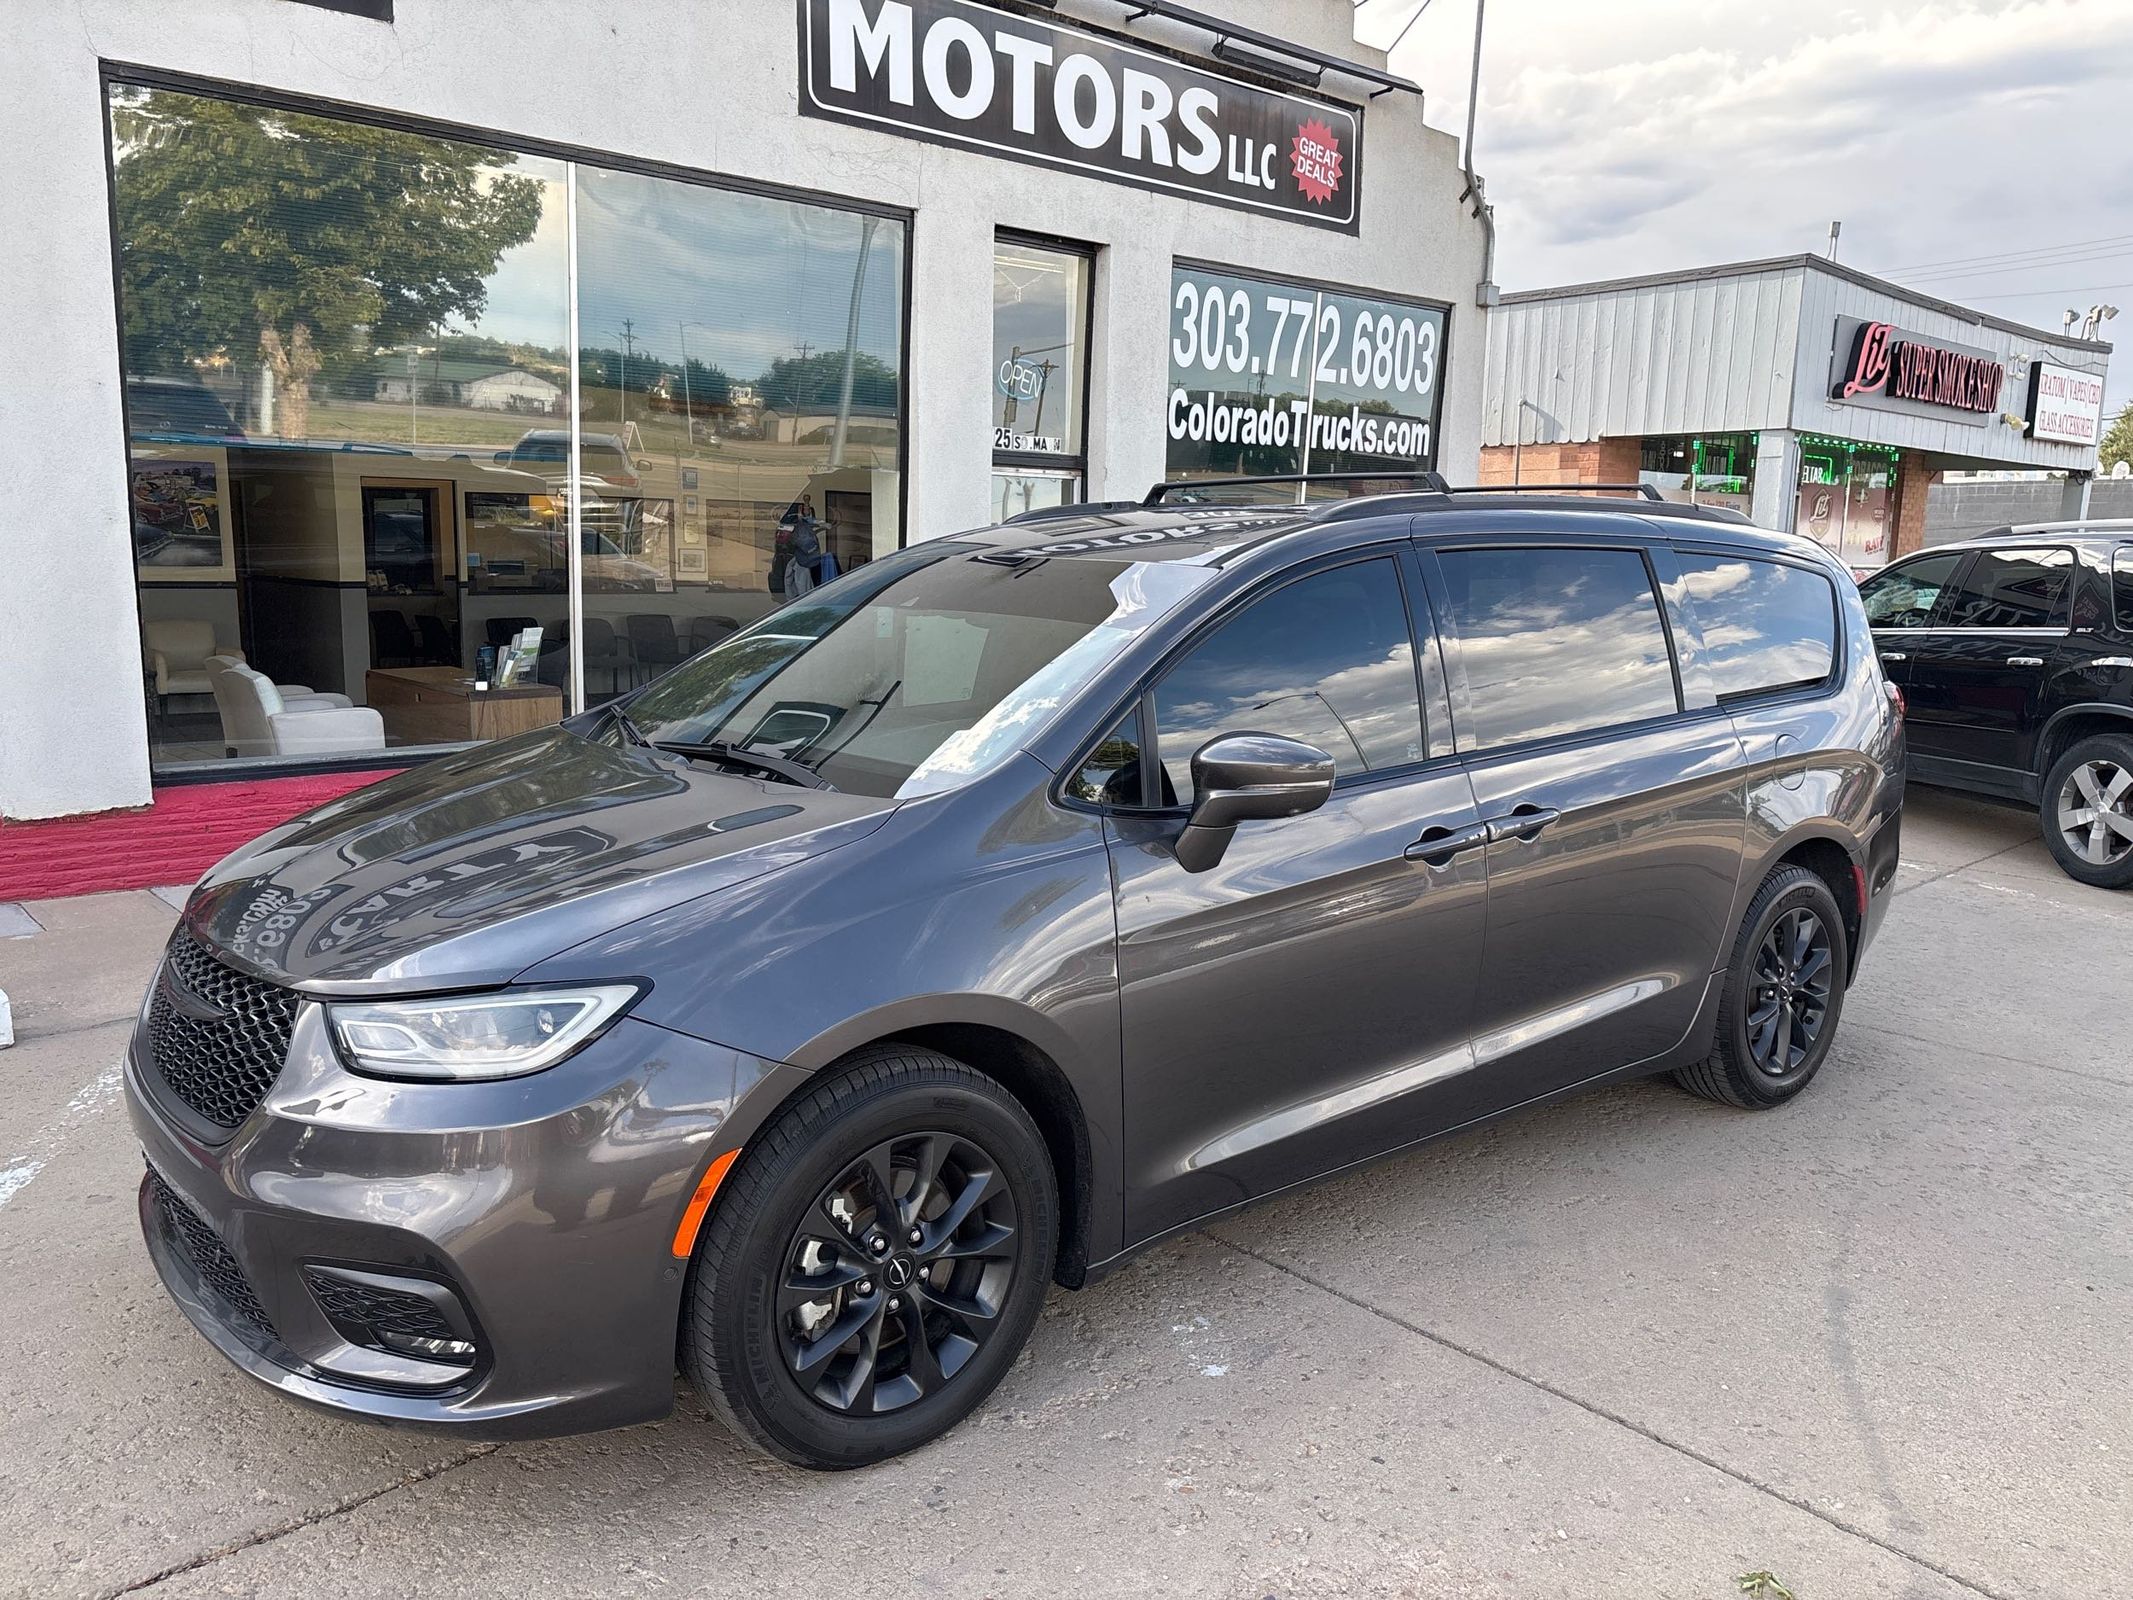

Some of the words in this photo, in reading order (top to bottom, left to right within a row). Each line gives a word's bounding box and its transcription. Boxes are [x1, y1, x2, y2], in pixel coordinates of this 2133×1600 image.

[829, 0, 1221, 175] MOTORS
[1227, 134, 1277, 190] LLC
[1296, 155, 1335, 188] DEALS
[1299, 136, 1338, 169] GREAT
[1172, 281, 1436, 395] 303.772.6803
[1000, 360, 1042, 398] OPEN
[1895, 341, 1937, 400] SUPER
[1935, 350, 1977, 409] SMOKE
[1973, 359, 2005, 413] SHOP
[1167, 387, 1430, 457] ColoradoTrucks.com
